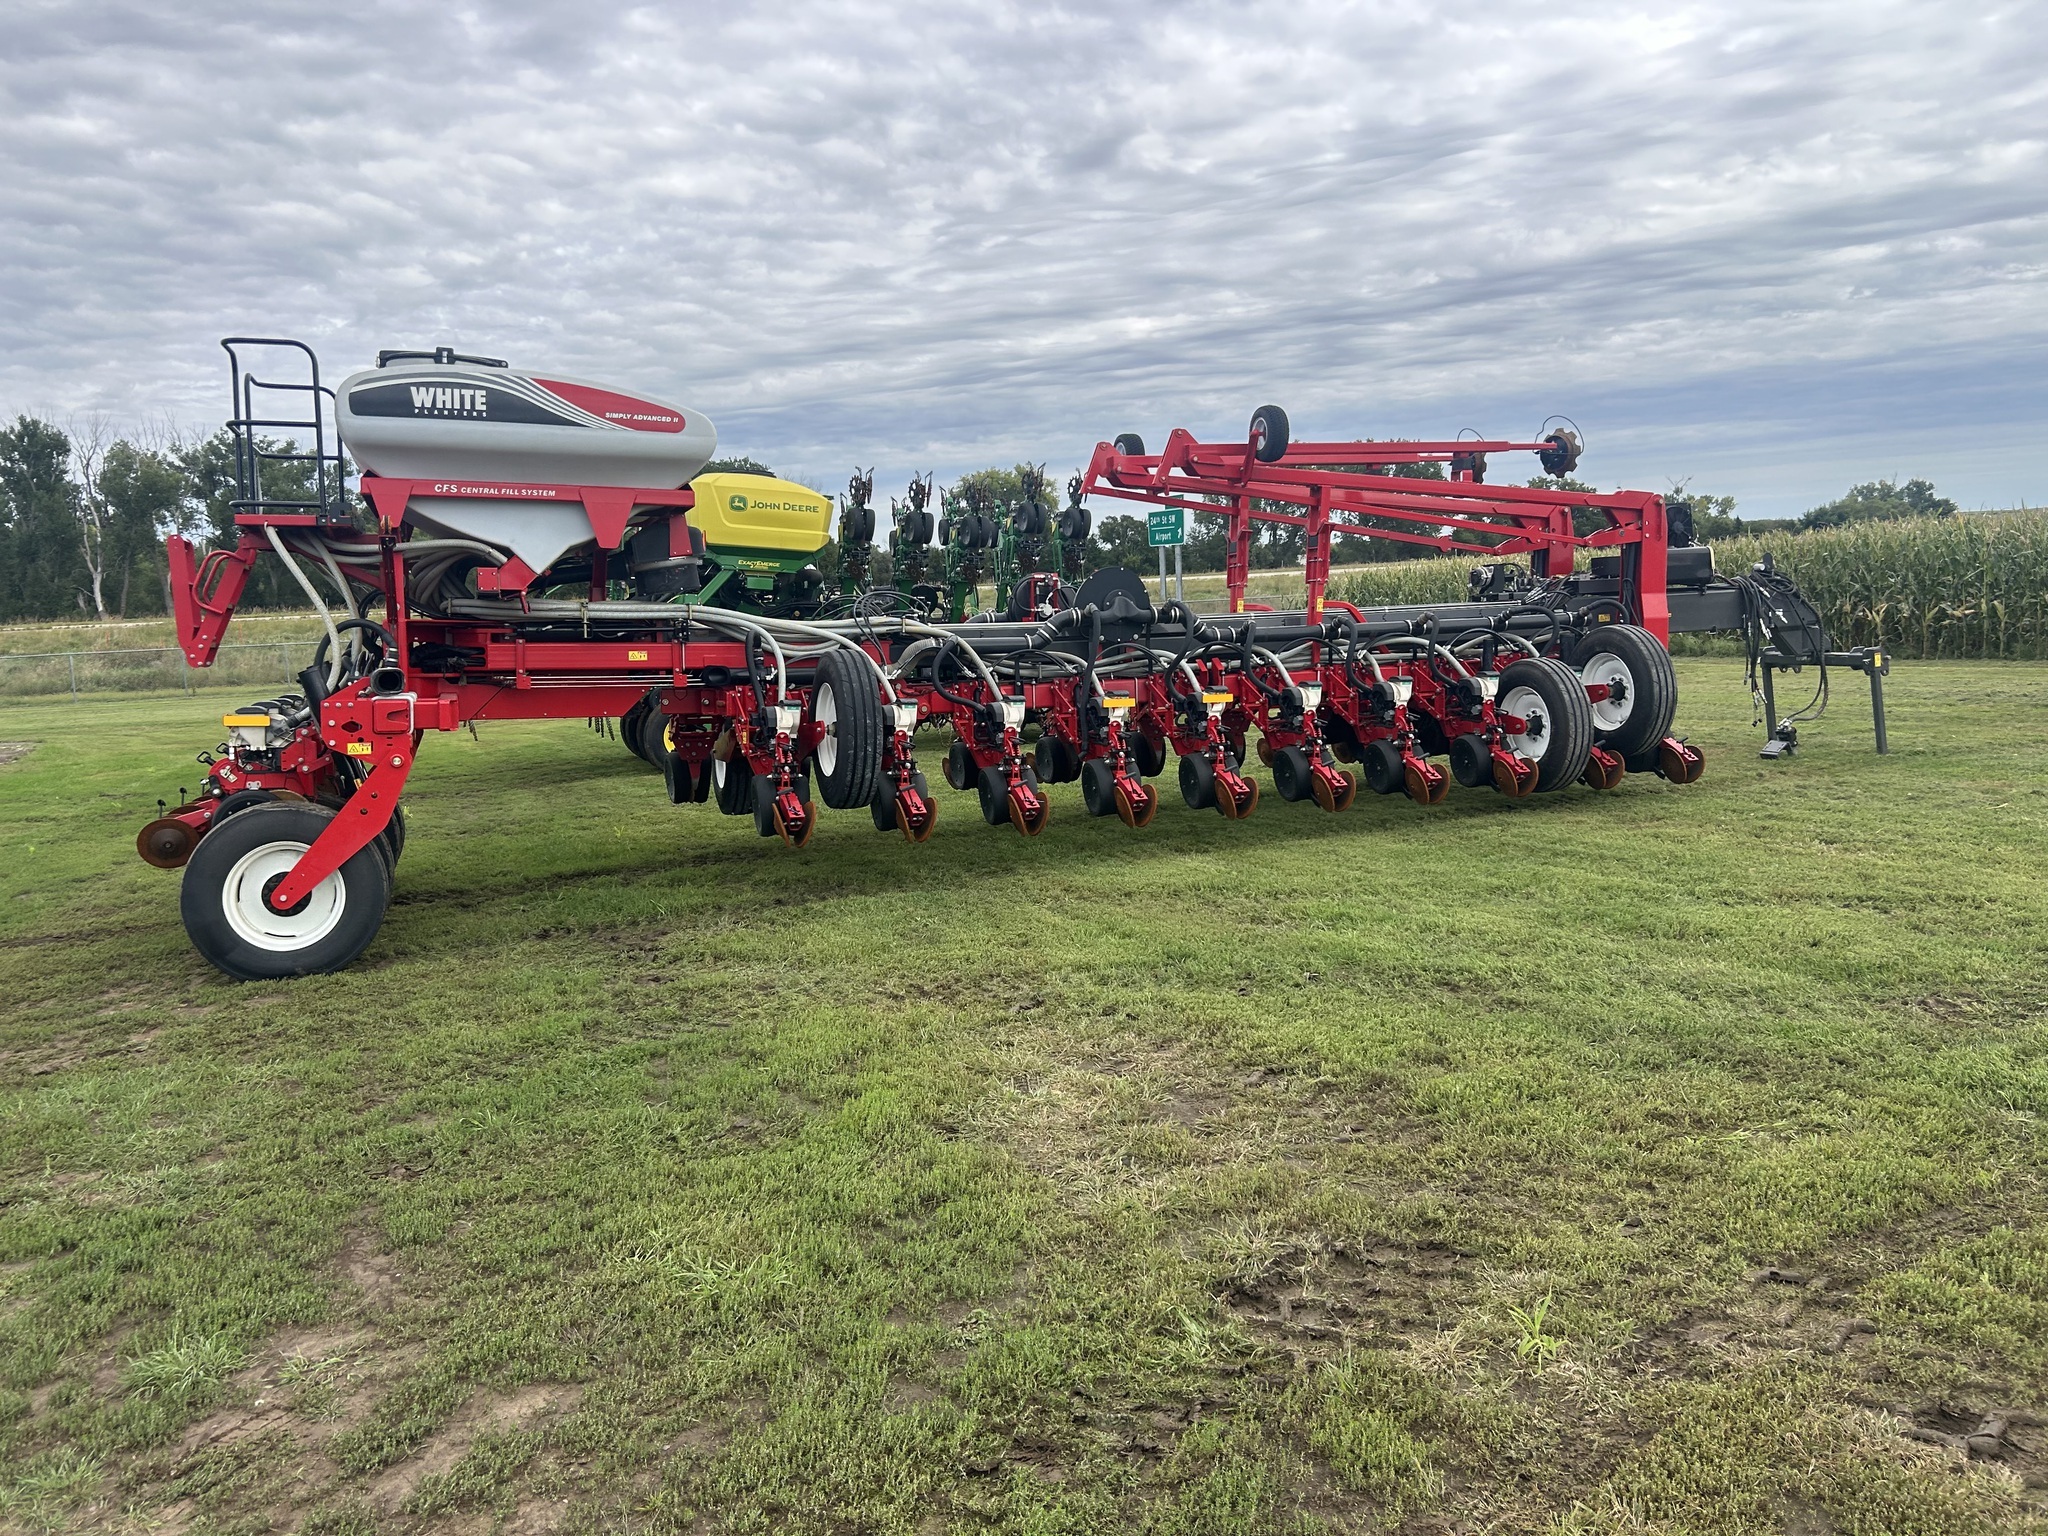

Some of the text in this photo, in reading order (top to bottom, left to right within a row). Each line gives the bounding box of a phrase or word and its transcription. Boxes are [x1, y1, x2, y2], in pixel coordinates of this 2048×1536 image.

[410, 386, 487, 411] WHITE
[414, 408, 487, 418] PLANTERS
[605, 412, 631, 420] SIMPLY
[632, 414, 672, 423] ADVANCED
[434, 484, 556, 497] CFS CENTRAL FILL SYSTEM
[750, 500, 820, 514] JOHN DEERE
[1155, 532, 1172, 542] Airport
